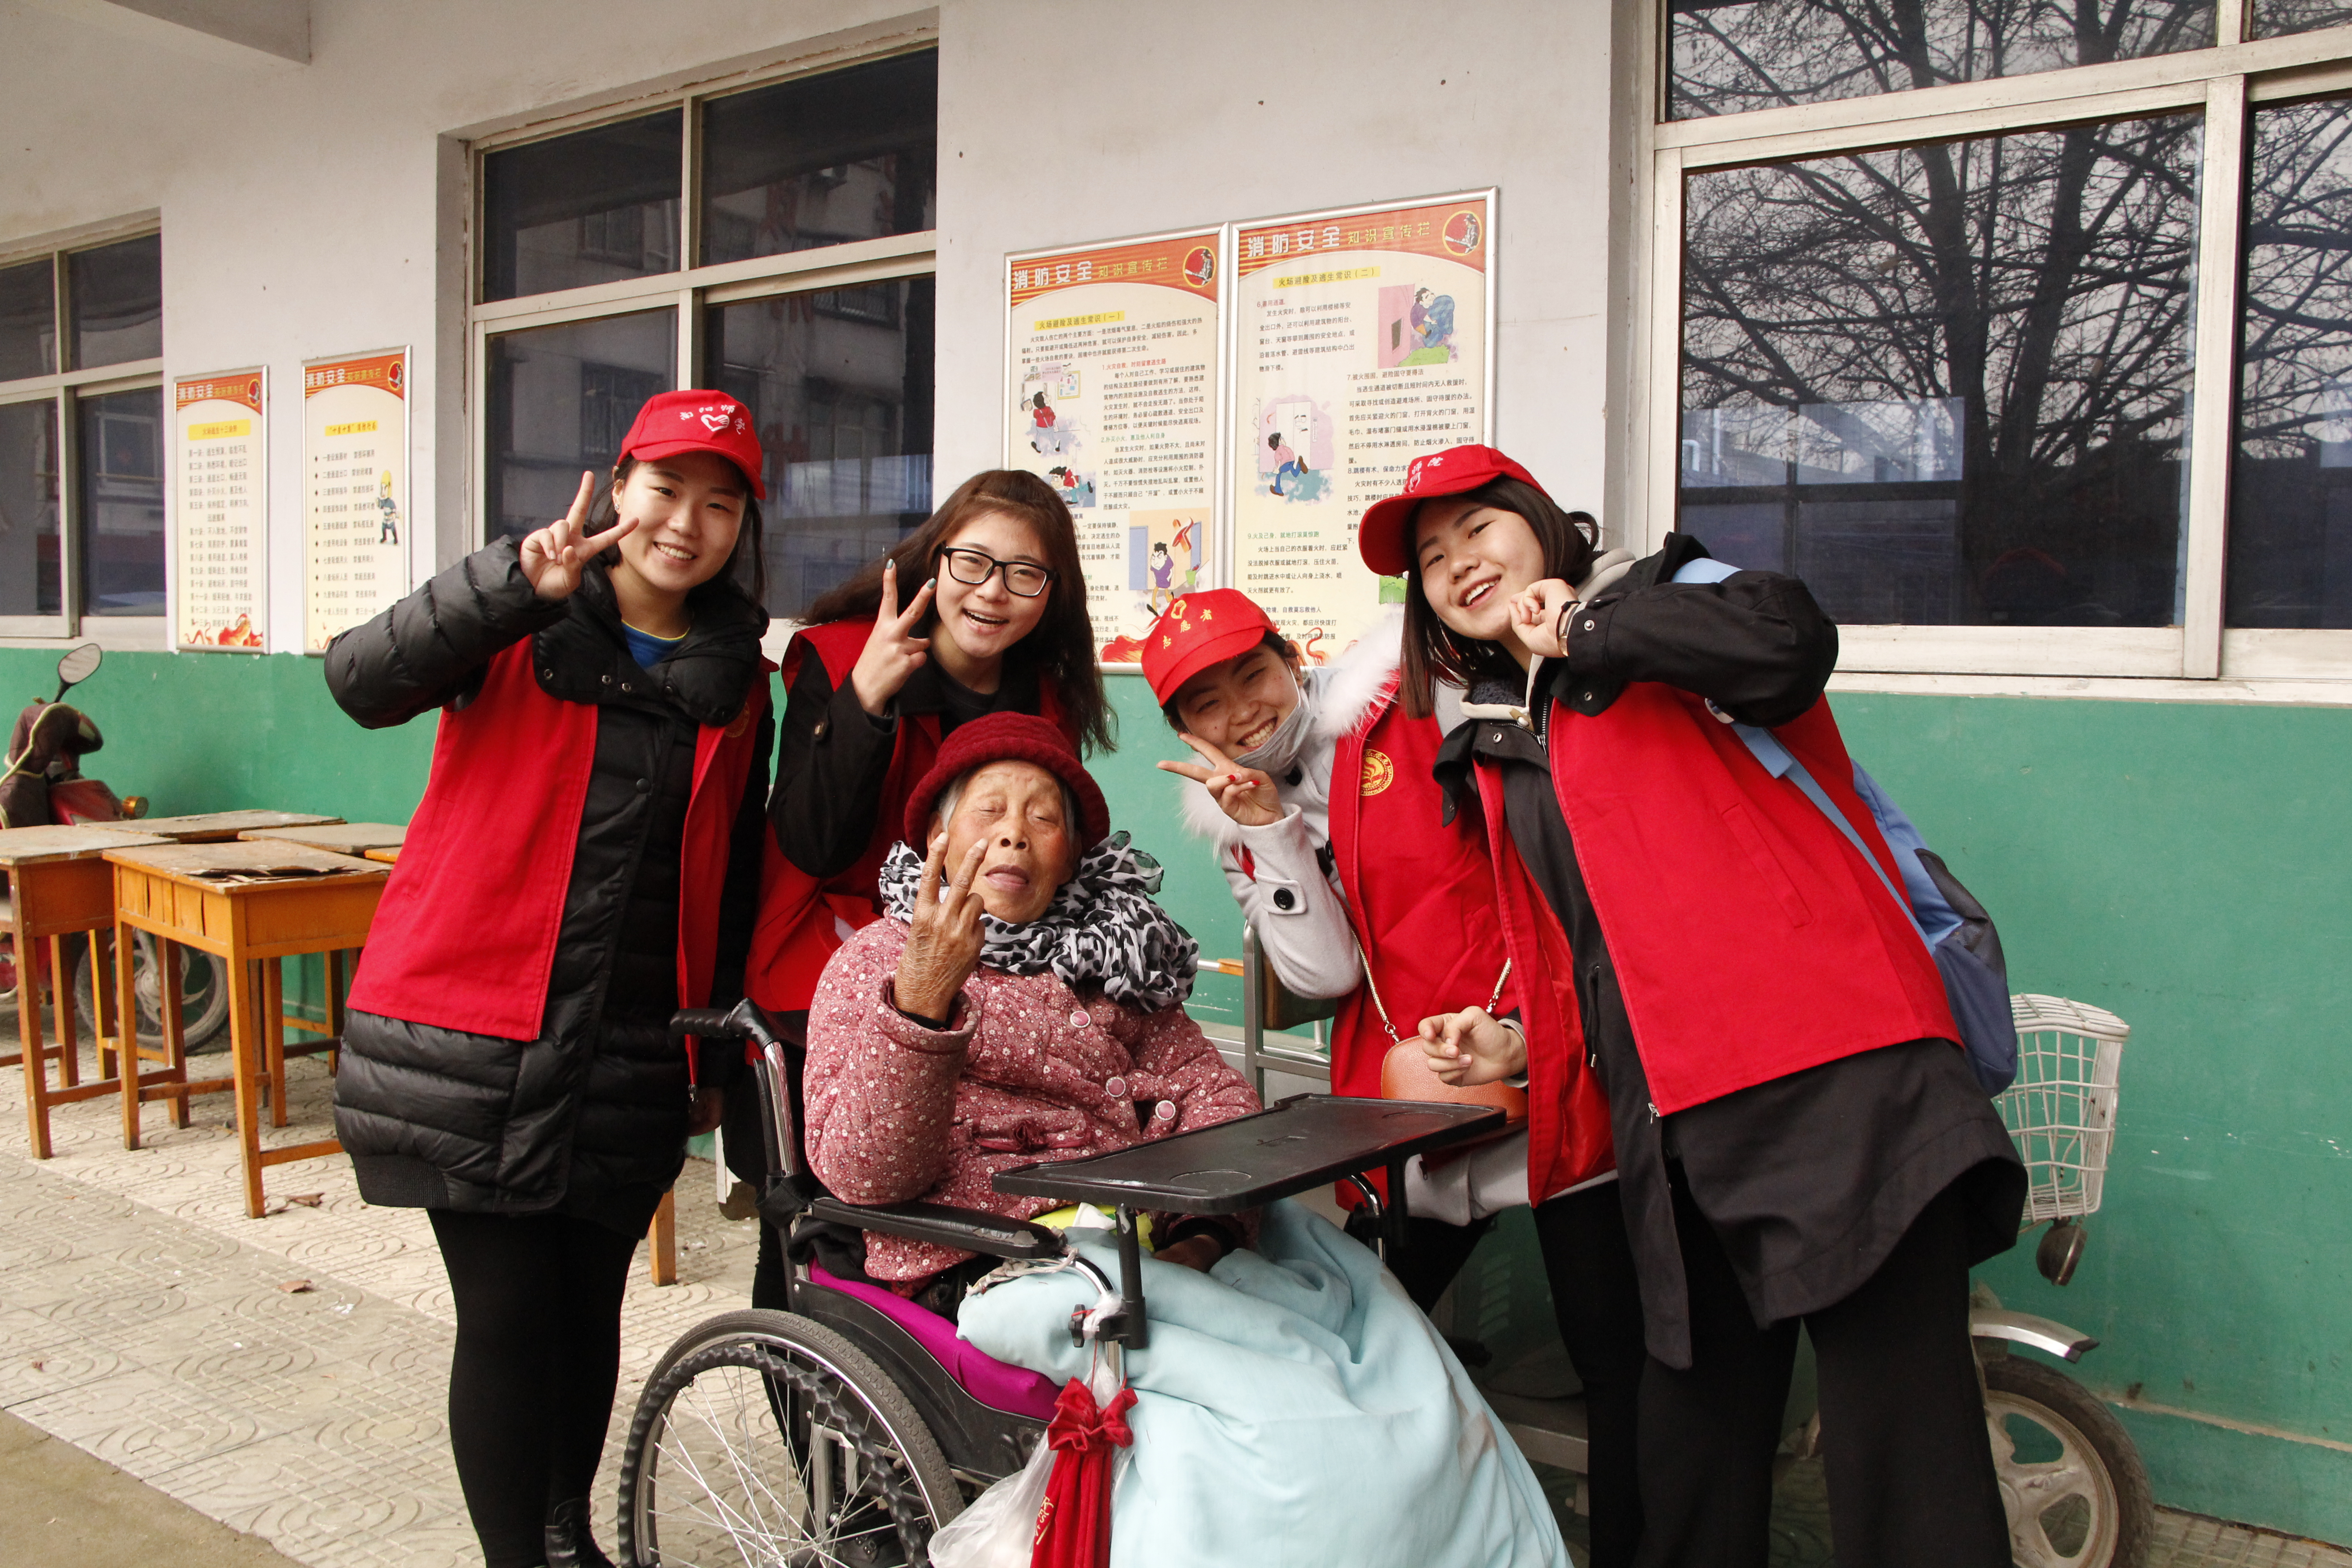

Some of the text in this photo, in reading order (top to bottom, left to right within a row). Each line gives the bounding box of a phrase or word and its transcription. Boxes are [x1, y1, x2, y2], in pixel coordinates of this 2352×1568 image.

[1247, 221, 1431, 258] 消防安全 知识宣传栏
[1014, 256, 1169, 290] 消防安全 知识宣传栏
[1278, 268, 1375, 287] 火场避险及逃生常识(二)
[1039, 312, 1120, 329] 火场避险及逃生常识(一)
[306, 368, 346, 387] 消防安全
[1259, 364, 1284, 372] 物滑下楼。
[1347, 369, 1424, 381] 7.被火围困,避险固守要得法
[1163, 609, 1212, 649] 志愿者
